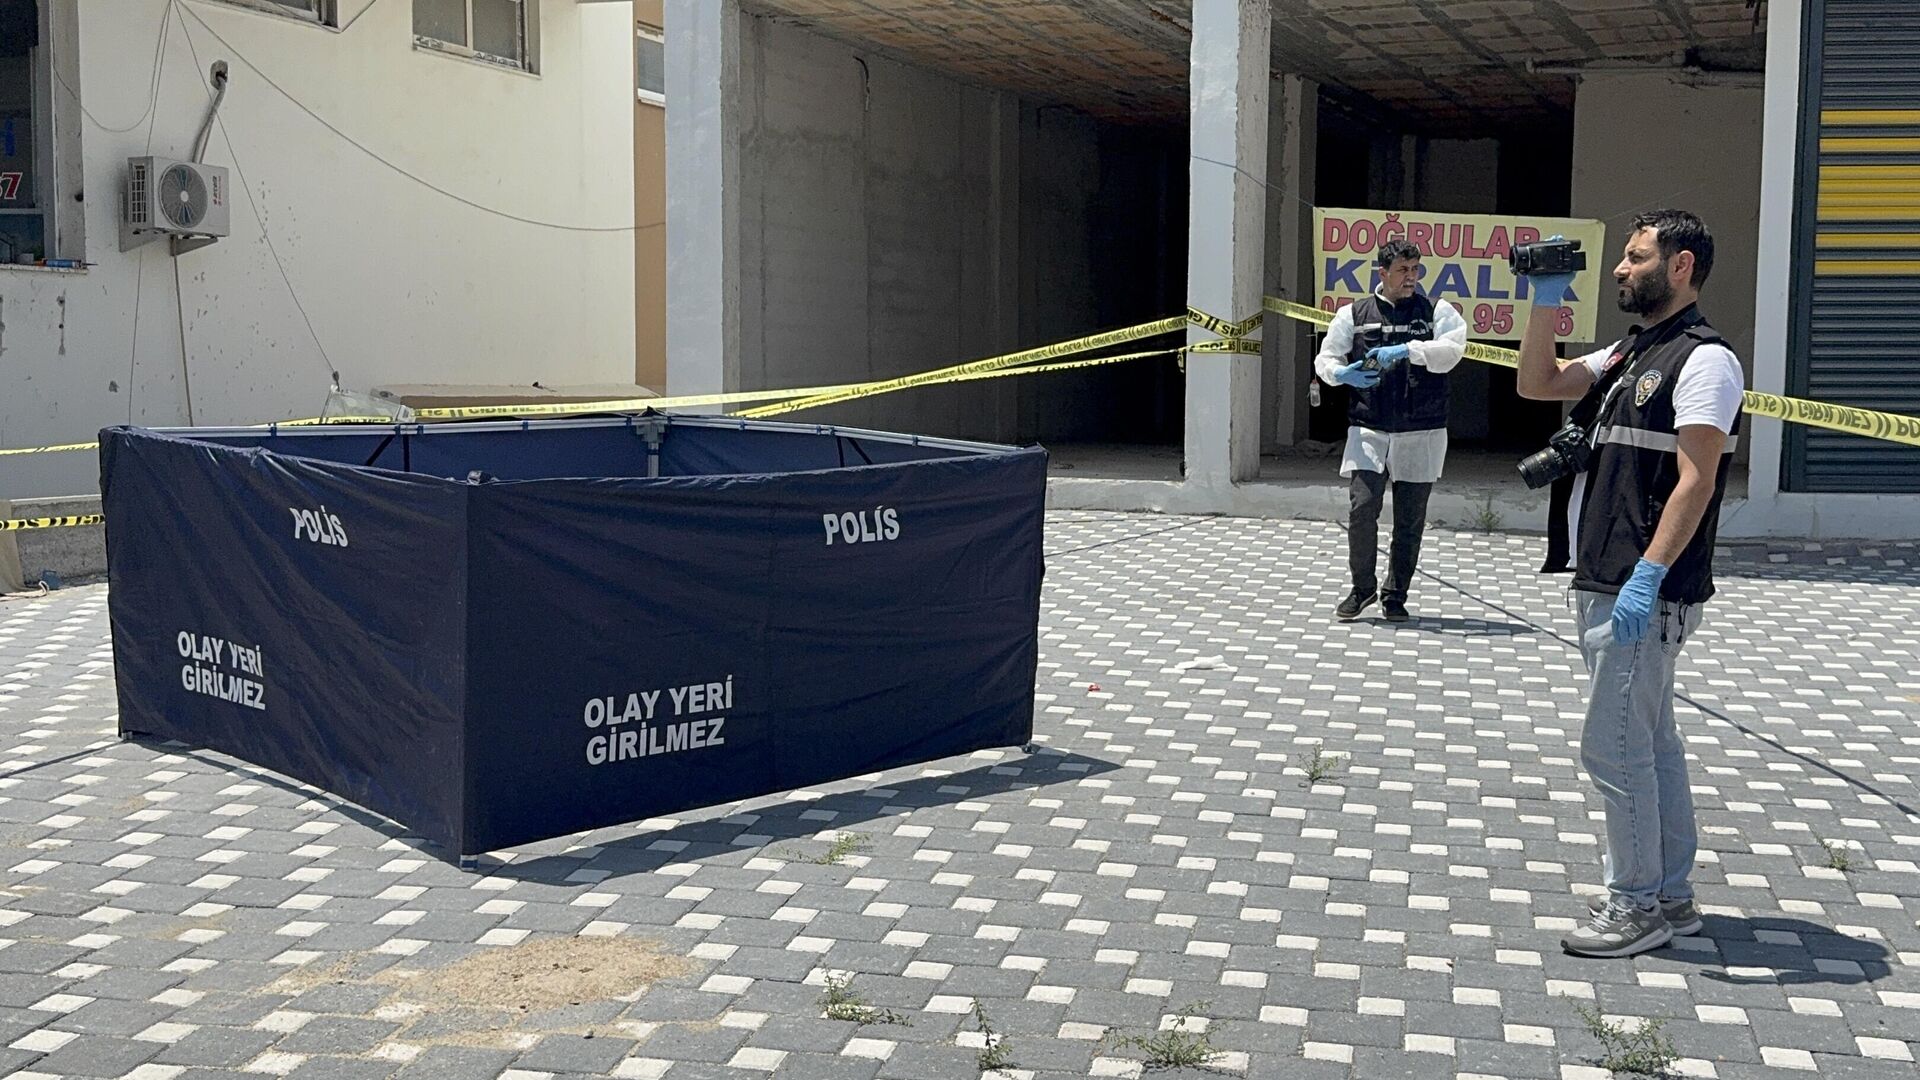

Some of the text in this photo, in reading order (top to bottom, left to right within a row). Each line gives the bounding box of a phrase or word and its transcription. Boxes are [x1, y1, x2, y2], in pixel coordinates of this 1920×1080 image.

[1473, 303, 1514, 335] 95
[289, 505, 349, 547] POLİS
[823, 505, 900, 545] POLİS
[178, 631, 263, 677] OLAY YERİ
[182, 661, 266, 710] GİRİLMEZ
[584, 674, 733, 728] OLAY YERİ
[586, 717, 725, 765] GİRİLMEZ
